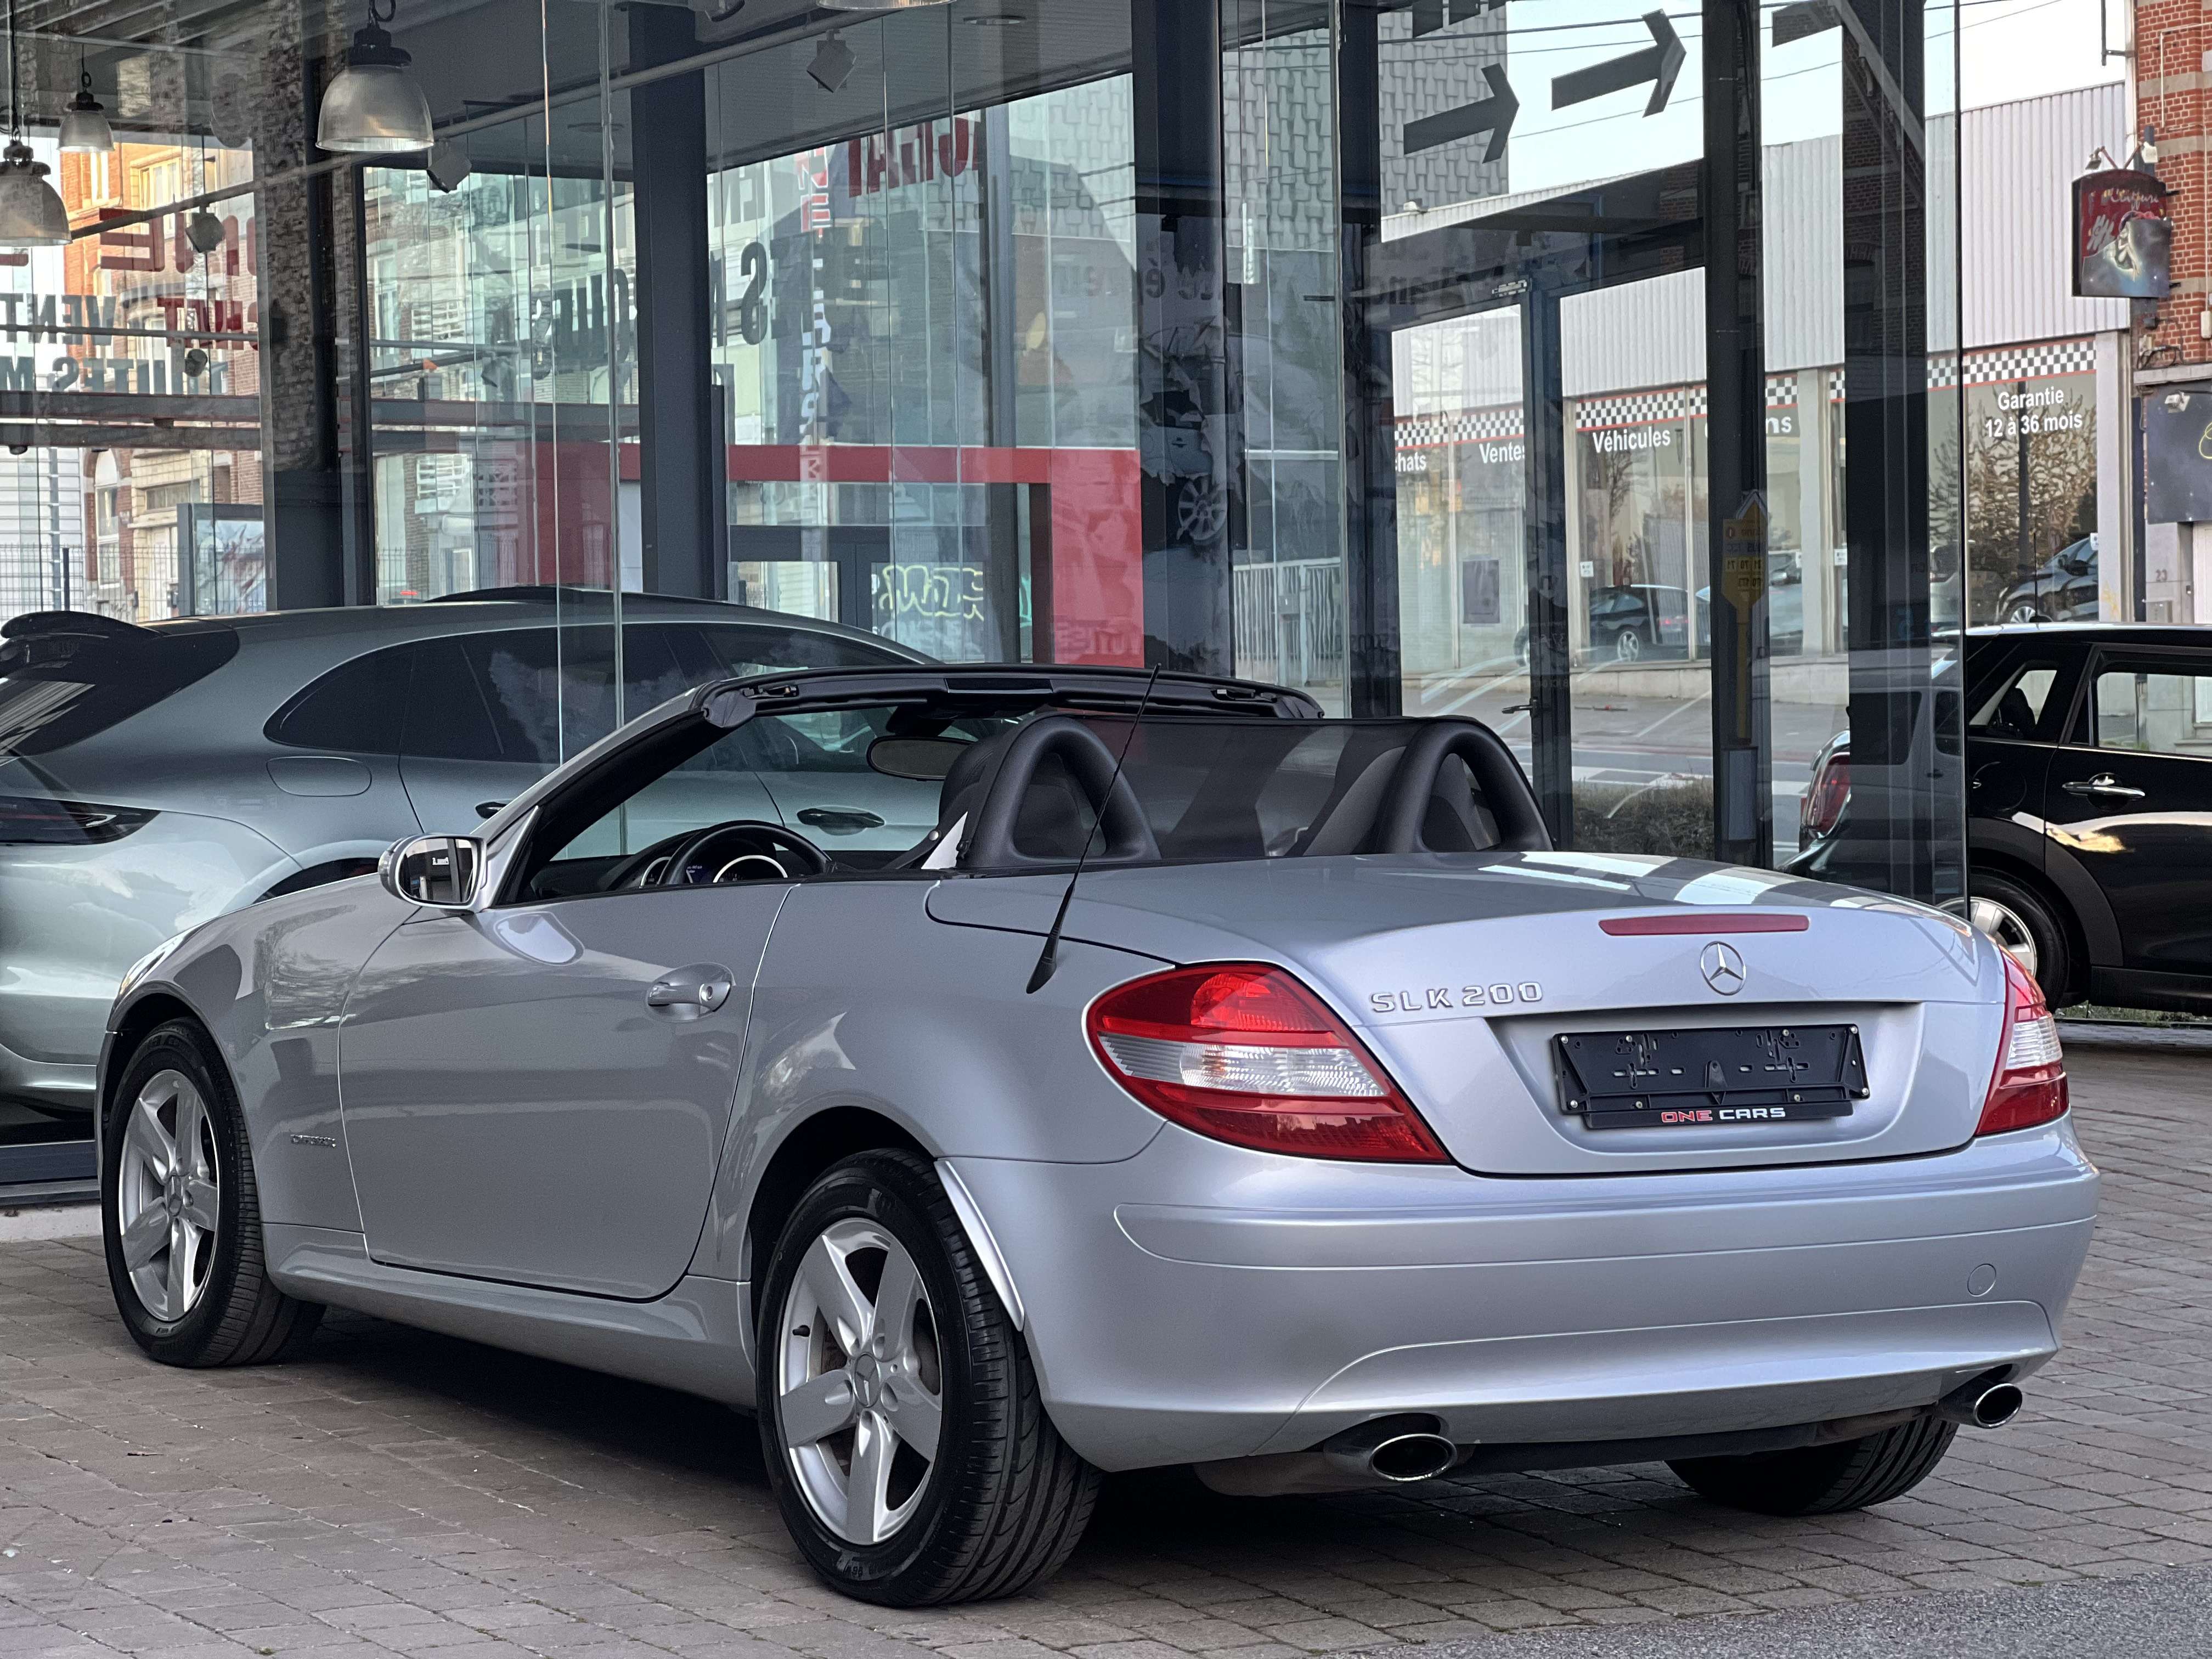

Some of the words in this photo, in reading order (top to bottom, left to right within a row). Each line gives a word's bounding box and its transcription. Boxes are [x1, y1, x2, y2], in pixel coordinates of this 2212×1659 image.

[1998, 386, 2064, 410] Garantie
[1985, 419, 2003, 437] 12
[2007, 416, 2016, 435] à
[2021, 414, 2039, 434] 36
[2044, 410, 2083, 431] mois
[1592, 426, 1671, 453] Véhicules
[1371, 988, 1453, 1013] SLK
[1462, 981, 1543, 1006] 200
[1661, 1110, 1713, 1123] ONE
[1719, 1107, 1786, 1120] CARS
